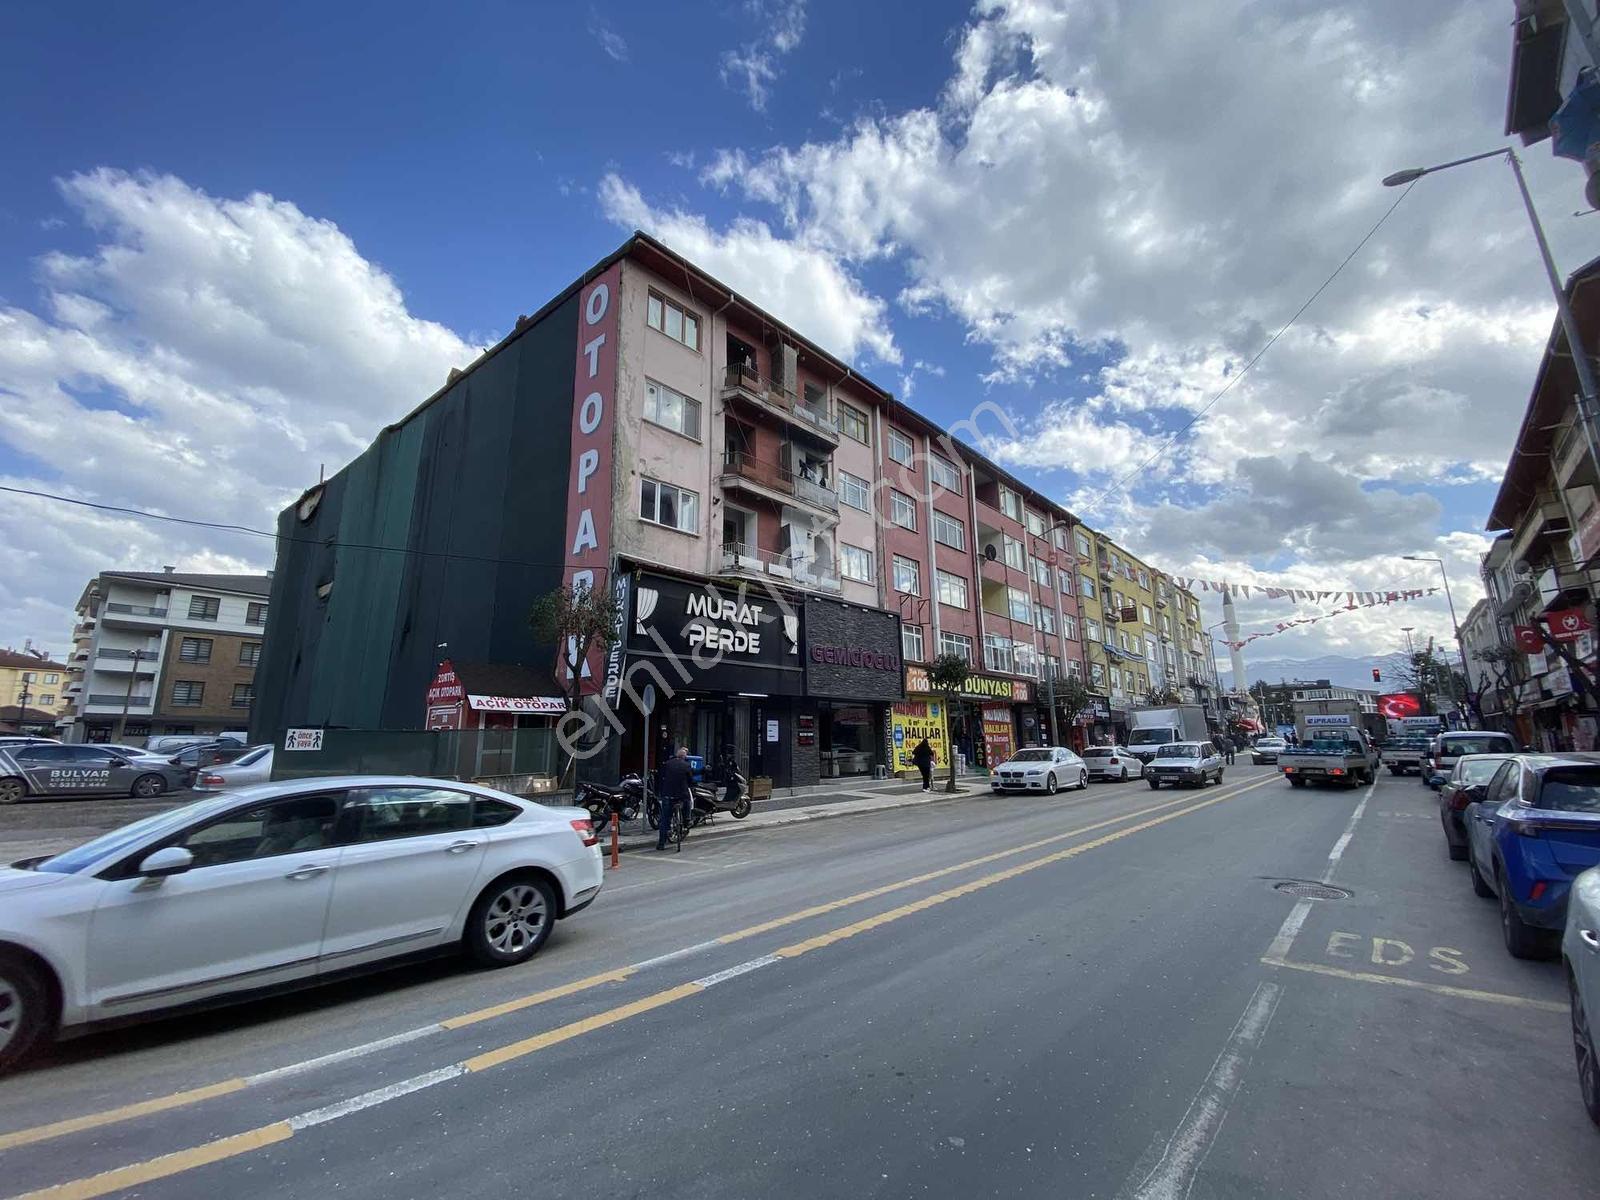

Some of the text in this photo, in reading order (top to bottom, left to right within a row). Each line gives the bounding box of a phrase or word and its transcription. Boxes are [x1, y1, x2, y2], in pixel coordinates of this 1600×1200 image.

[686, 592, 763, 626] MURAT
[605, 577, 627, 698] MURAT PERDE
[689, 623, 761, 654] PERDE
[911, 677, 929, 691] 100
[965, 675, 1012, 697] DÜNYASI
[476, 699, 510, 709] AÇIK
[513, 701, 567, 709] OTOPAR
[905, 726, 941, 739] HALILAR
[50, 770, 110, 778] BULVAR
[1325, 931, 1471, 975] EDS
